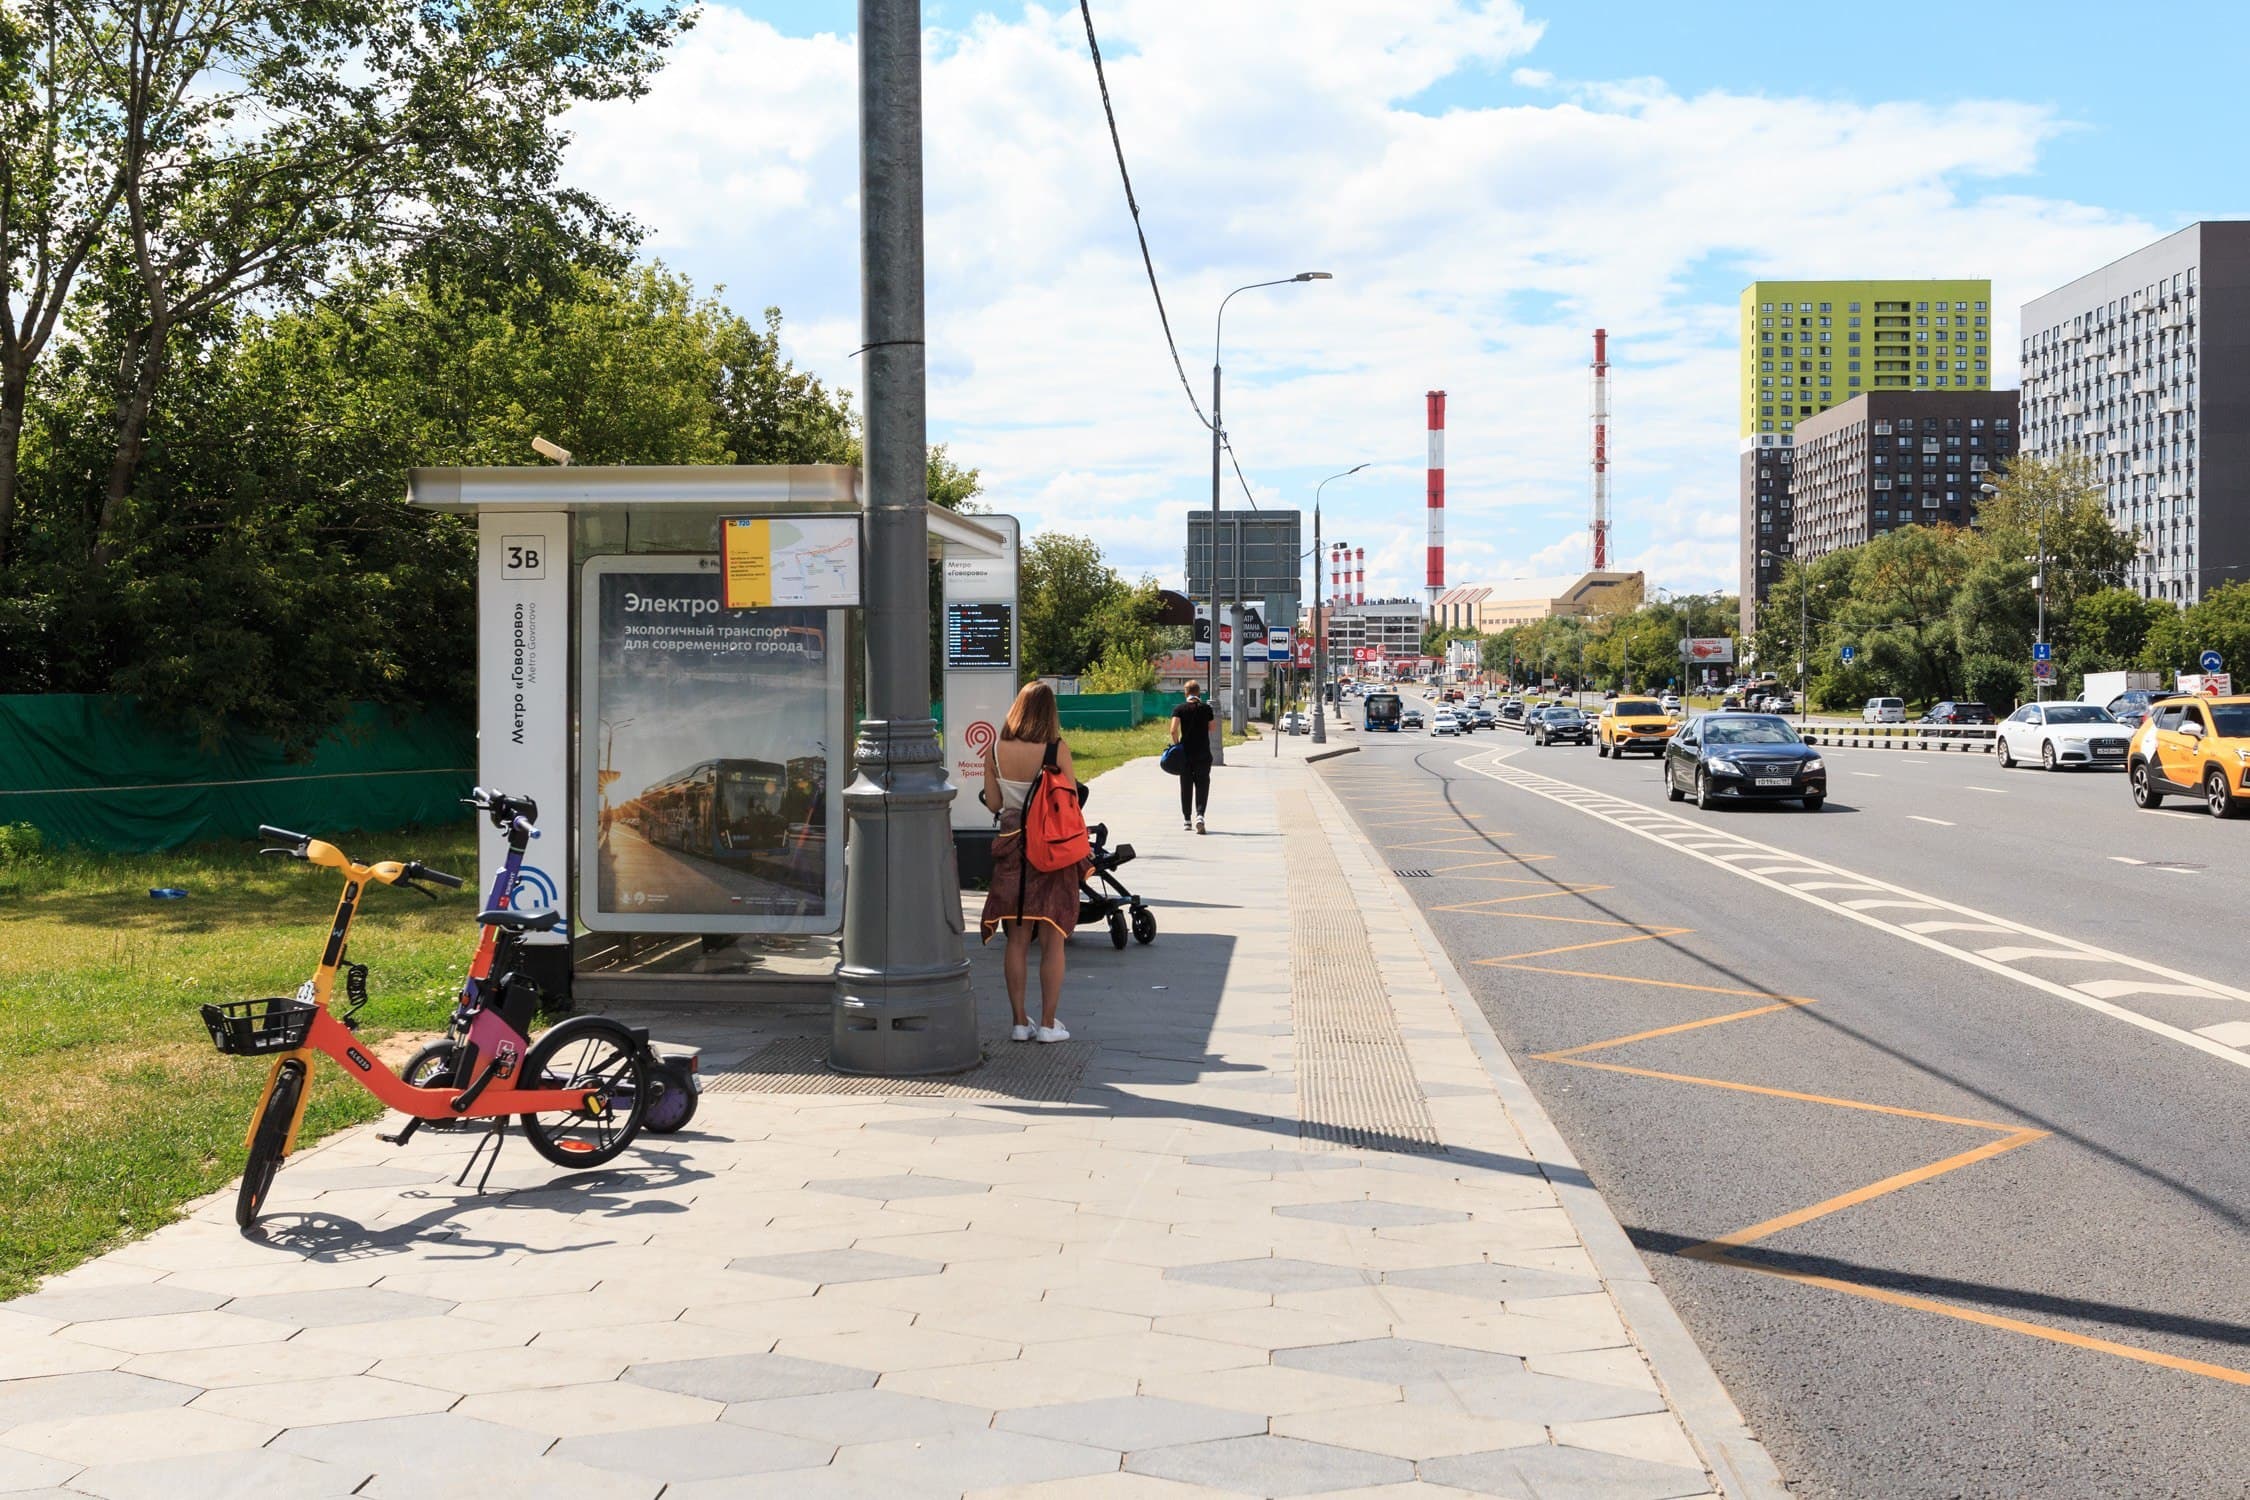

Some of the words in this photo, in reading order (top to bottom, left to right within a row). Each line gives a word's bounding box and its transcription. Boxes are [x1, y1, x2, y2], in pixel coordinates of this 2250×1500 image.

[948, 561, 972, 570] Метро
[625, 593, 758, 617] Электро
[1243, 615, 1254, 623] АТР
[527, 603, 537, 650] Govorovo
[625, 625, 715, 636] экологичный
[718, 626, 790, 639] транспорт
[1203, 626, 1209, 638] 2
[512, 603, 526, 689] «Говорово»
[624, 639, 648, 650] для
[653, 640, 751, 652] современного
[756, 641, 804, 653] города
[527, 652, 537, 683] Metro
[512, 694, 526, 744] Метро
[961, 769, 985, 778] Транс
